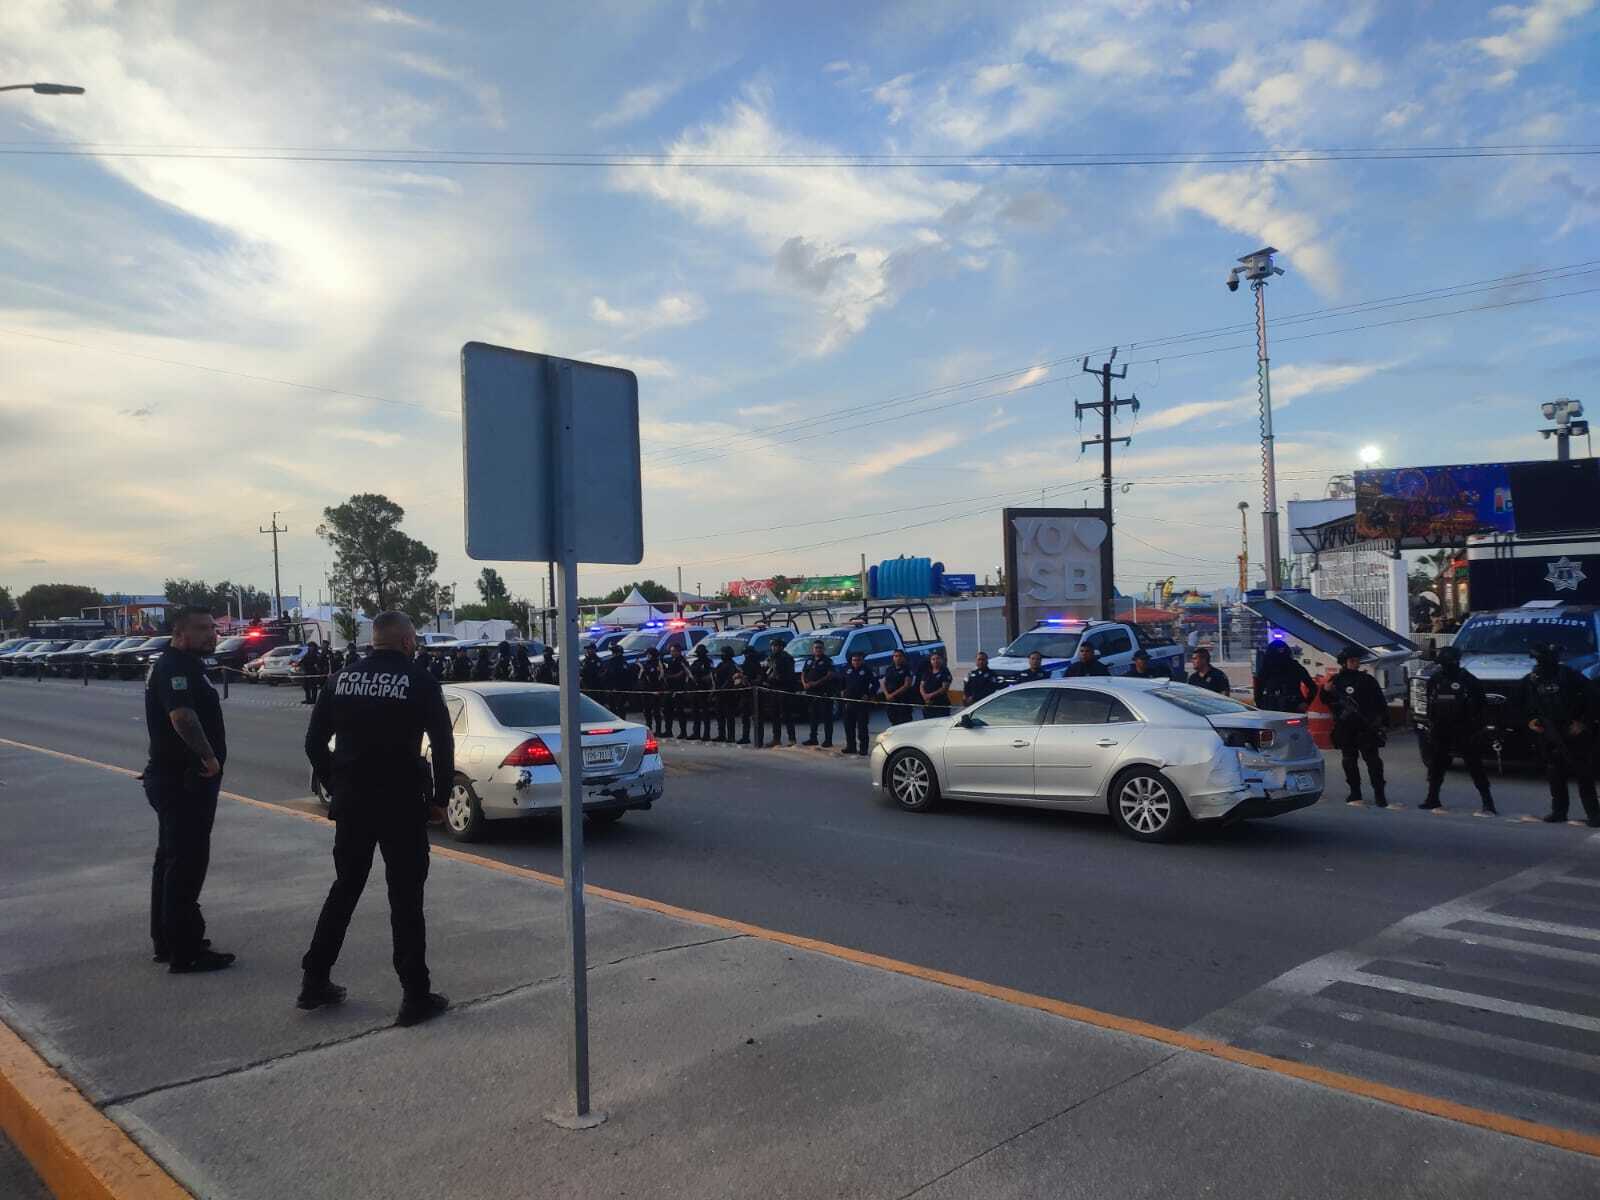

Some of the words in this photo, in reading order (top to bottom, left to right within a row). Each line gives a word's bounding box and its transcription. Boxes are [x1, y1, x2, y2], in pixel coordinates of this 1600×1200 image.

[1012, 518, 1071, 556] YO
[1026, 559, 1098, 600] SB
[335, 682, 407, 699] MUNICIPAL
[337, 672, 409, 687] POLICIA
